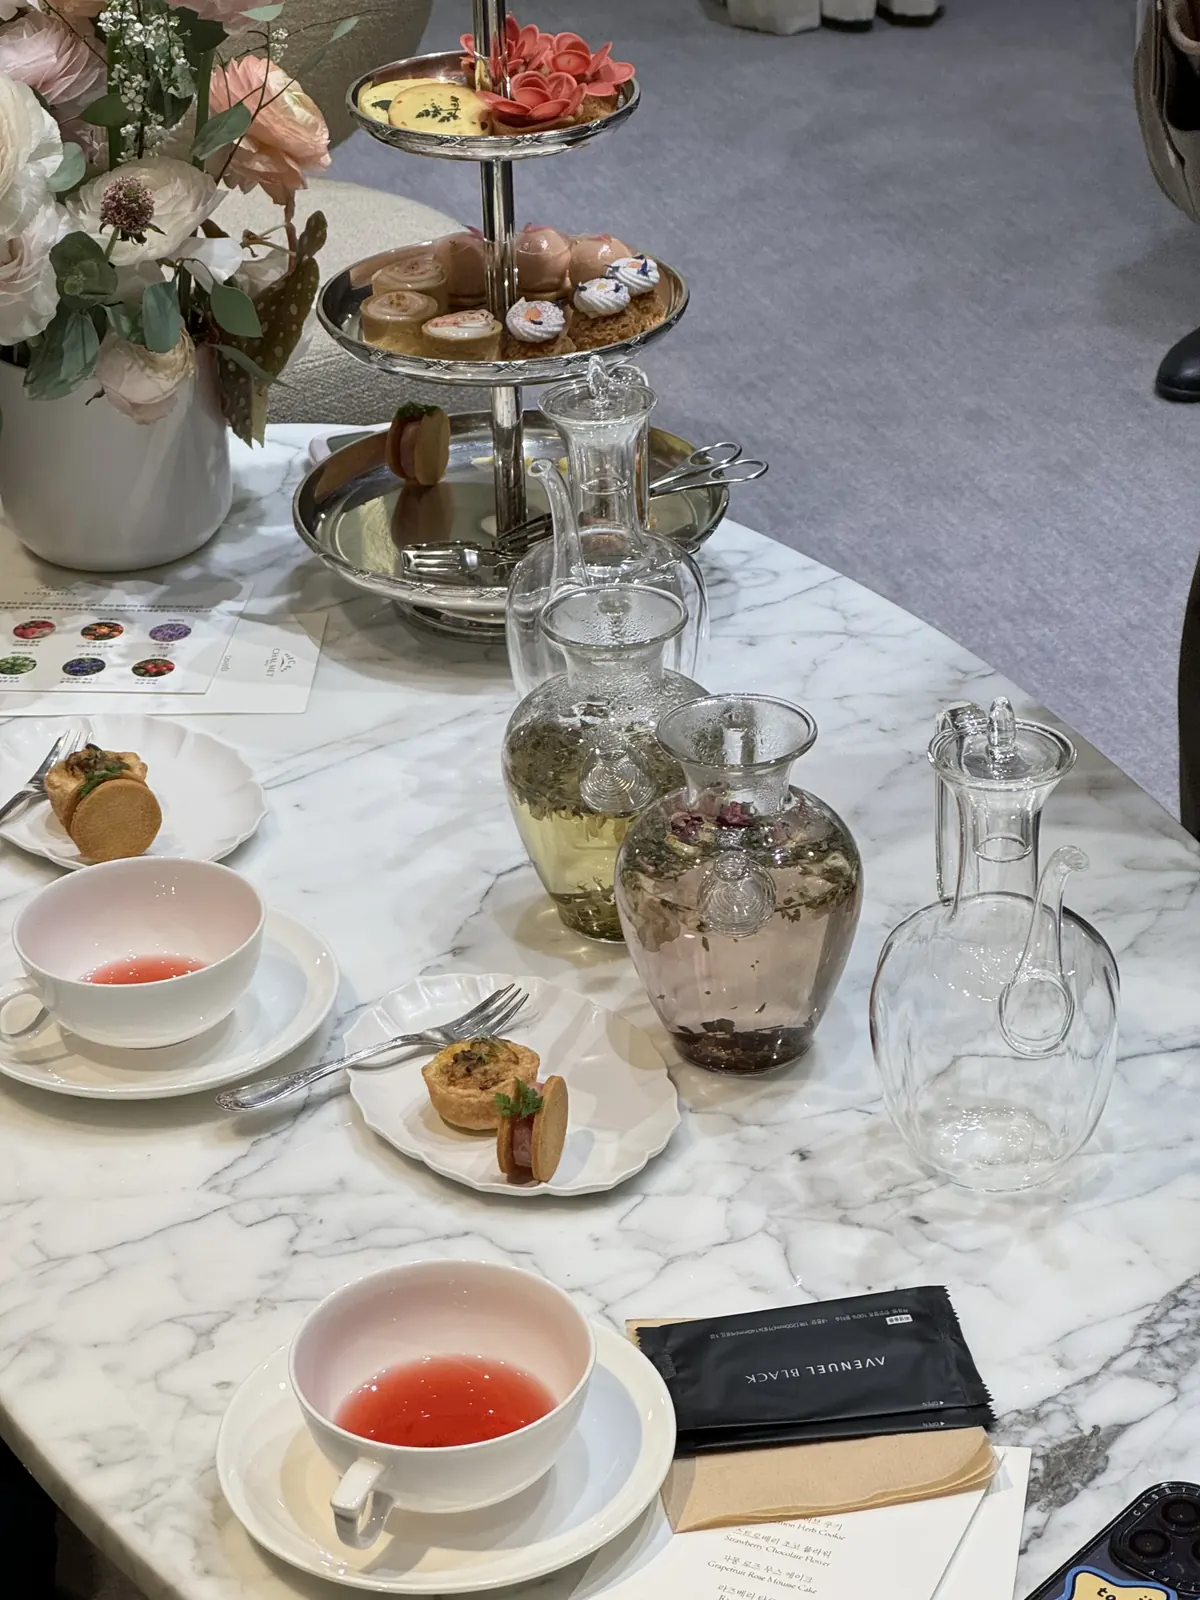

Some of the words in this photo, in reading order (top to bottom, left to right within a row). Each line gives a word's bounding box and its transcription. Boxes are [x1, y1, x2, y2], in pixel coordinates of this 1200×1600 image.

[744, 1367, 800, 1385] BLACK
[805, 1355, 886, 1376] AVENUEL
[797, 1523, 818, 1533] Herb
[723, 1534, 763, 1551] Strawberry
[765, 1545, 804, 1561] Chocolate
[804, 1555, 831, 1567] Flower
[707, 1560, 746, 1577] Grapefruit
[747, 1571, 766, 1582] Rose
[766, 1576, 797, 1589] Mousse
[797, 1584, 818, 1595] Cake
